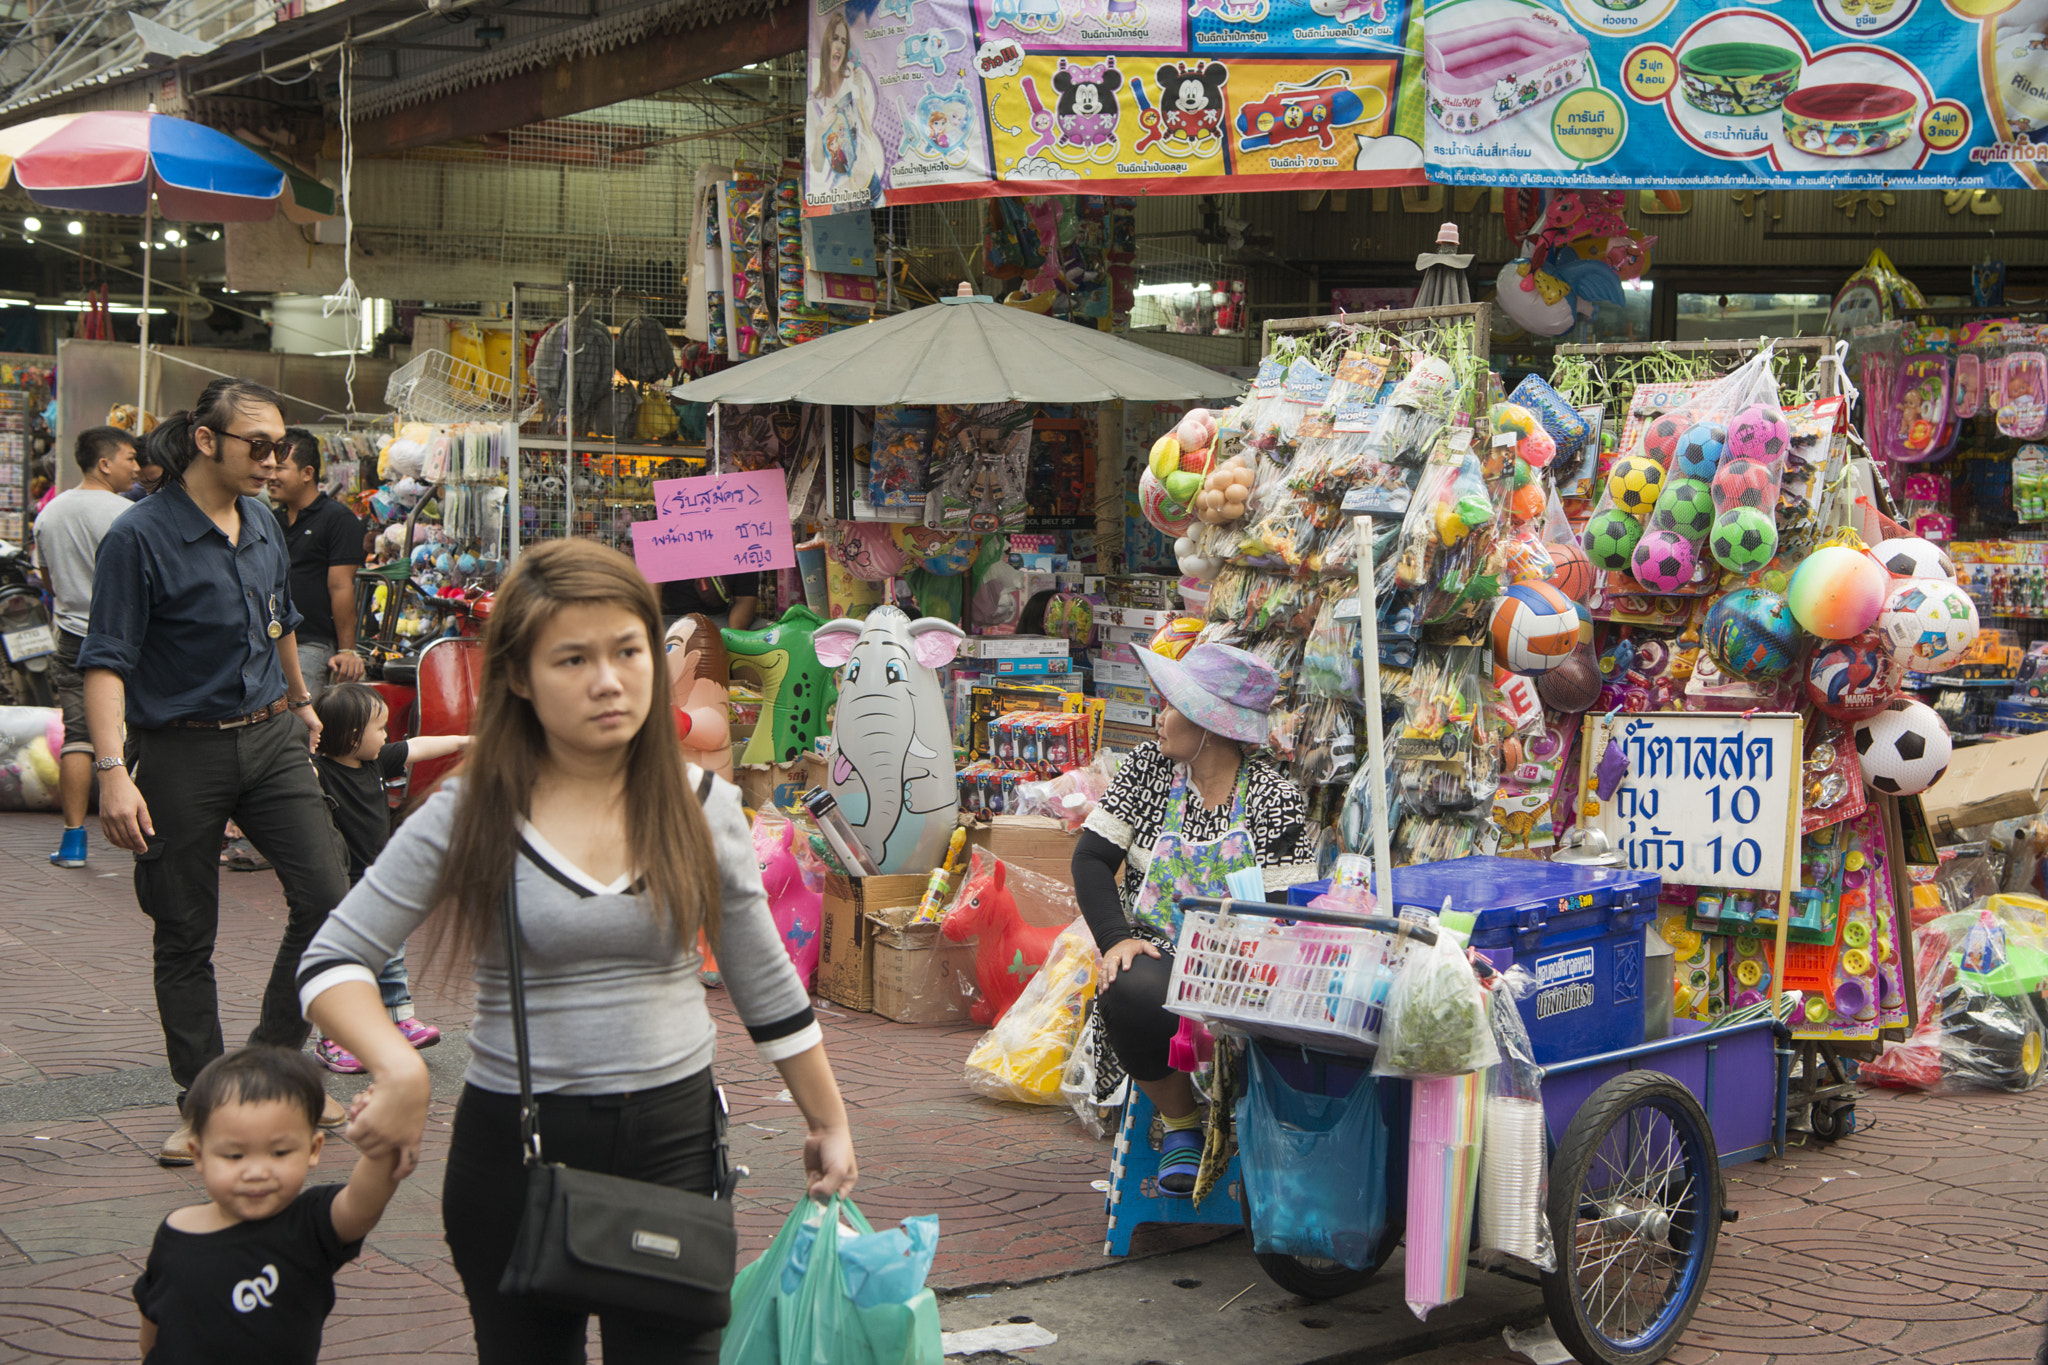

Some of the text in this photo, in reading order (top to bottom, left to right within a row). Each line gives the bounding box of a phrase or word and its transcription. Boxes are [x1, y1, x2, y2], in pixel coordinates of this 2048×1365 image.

[1602, 14, 1638, 25] ห่วงยาง
[1855, 14, 1877, 27] ชูชีพ
[1362, 28, 1374, 36] 40
[1639, 59, 1663, 72] 5 ฟุต
[1636, 73, 1665, 84] 4 ลอน
[1568, 110, 1606, 123] การันตี
[1932, 111, 1957, 124] 4 ฟุต
[1704, 125, 1768, 141] สระน้ำกันลื่น
[1928, 125, 1958, 137] 3 ลอน
[1972, 143, 2010, 162] สนุกได้
[1269, 156, 1338, 168] ปืนฉีดน้ำ 70 ซม.
[1887, 174, 1984, 187] www.keaktoy.com
[1260, 378, 1281, 388] WOR
[1291, 382, 1322, 391] WORLD
[1337, 410, 1369, 421] WORLD
[1024, 518, 1040, 526] OOL
[1061, 518, 1077, 526] SET
[652, 521, 772, 546] พนักงาน ชาย
[734, 543, 772, 568] หญิง
[1508, 680, 1533, 717] E
[1845, 693, 1874, 704] MARVEL
[1616, 784, 1761, 834] ถุง 10
[1706, 836, 1762, 877] 10
